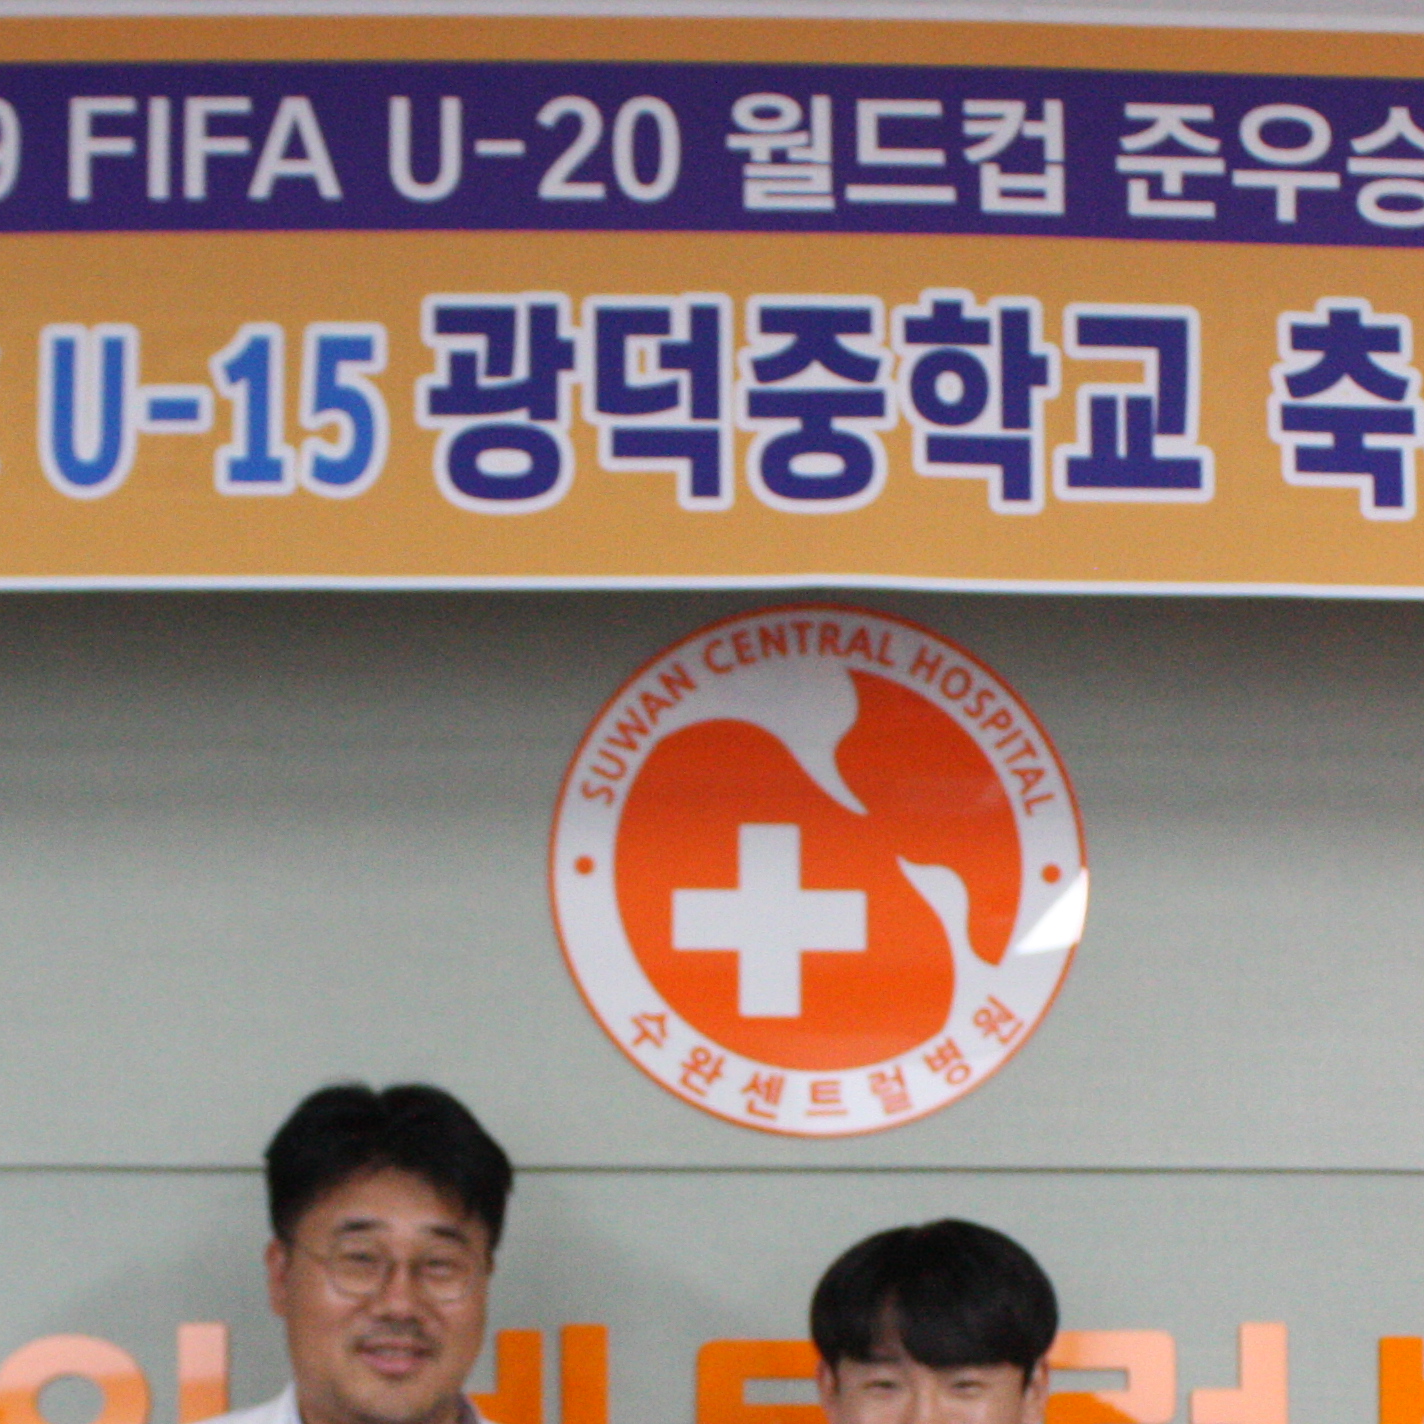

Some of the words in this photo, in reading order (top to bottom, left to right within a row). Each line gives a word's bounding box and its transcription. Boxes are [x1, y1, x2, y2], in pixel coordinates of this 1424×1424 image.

[67, 95, 343, 203] FIFA
[387, 93, 682, 205] U-20
[724, 92, 1067, 216] 월드컵
[49, 332, 380, 487] U-15
[426, 296, 1206, 504] 광덕중학교
[582, 663, 697, 808] SUWAN
[702, 619, 896, 676] CENTRAL
[908, 643, 1061, 817] HOSPITAL
[631, 994, 1025, 1120] 수완센트럴병원
